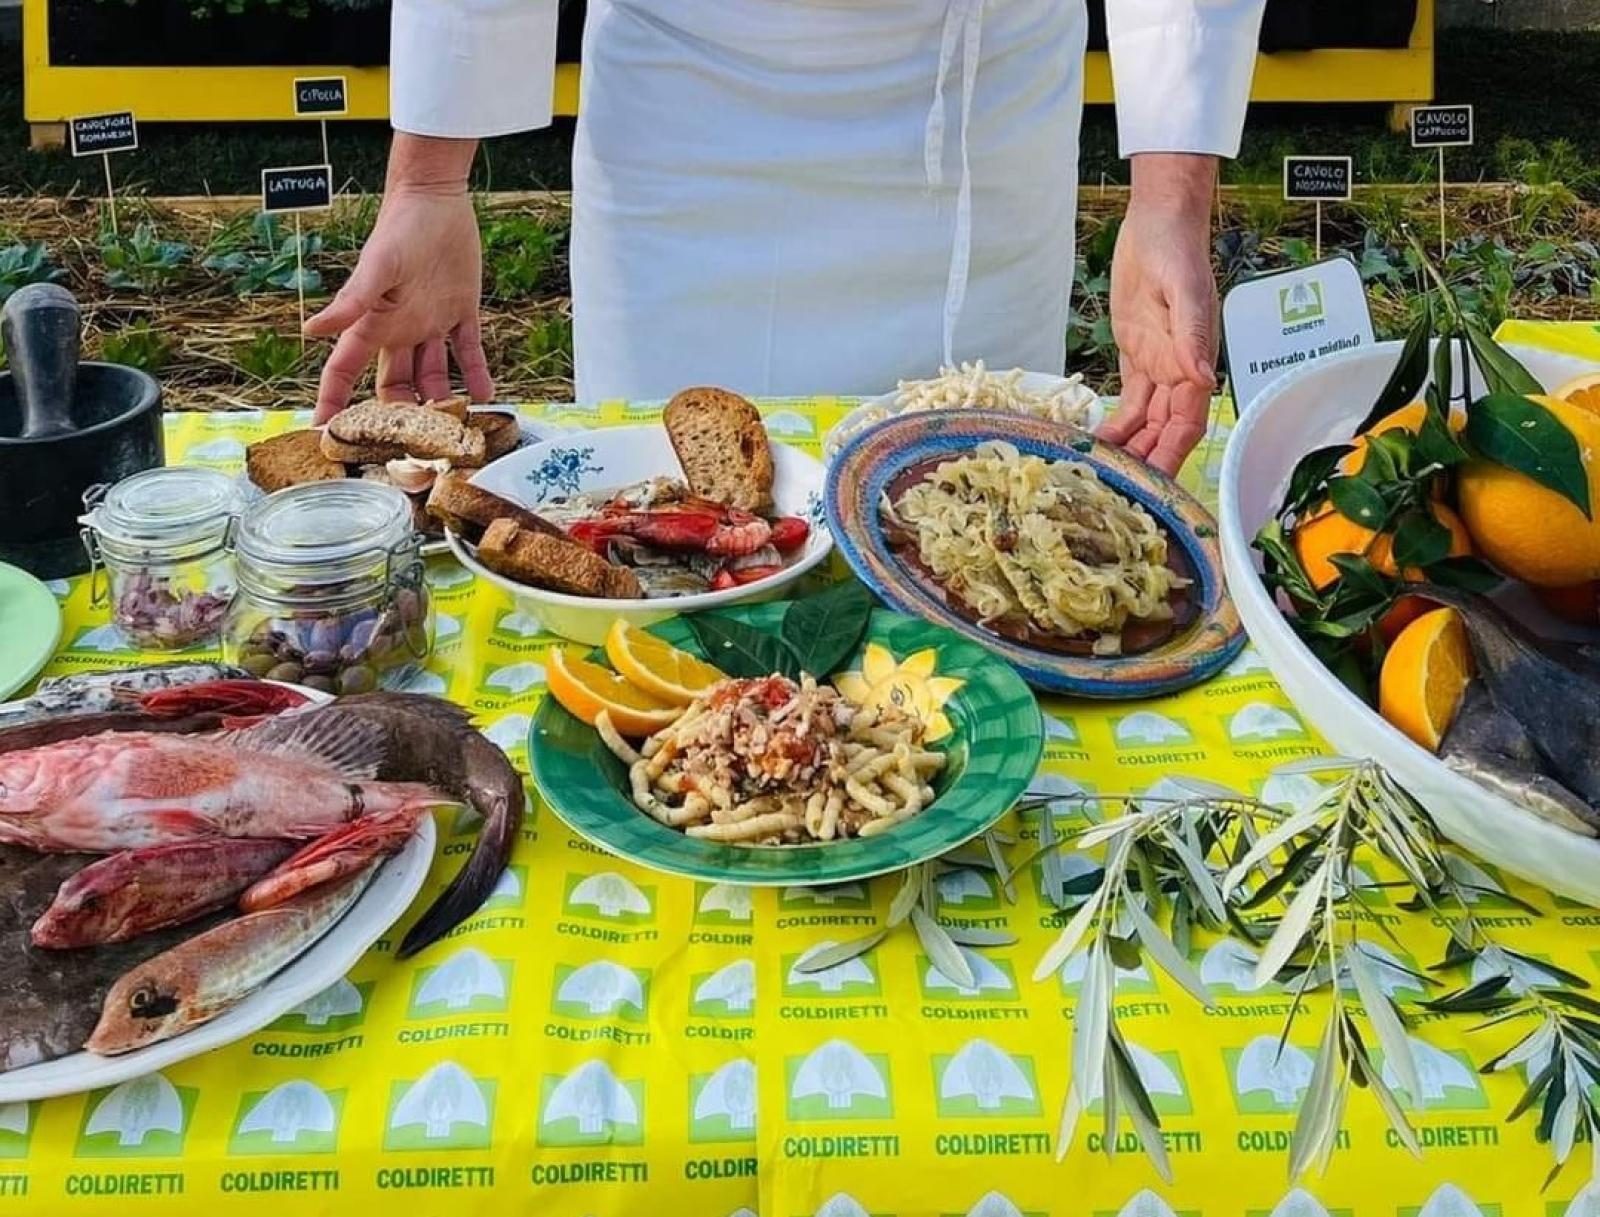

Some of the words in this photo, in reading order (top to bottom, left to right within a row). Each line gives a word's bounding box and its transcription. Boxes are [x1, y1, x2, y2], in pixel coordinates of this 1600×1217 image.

[1416, 111, 1467, 125] CAVOLO
[1294, 164, 1345, 179] CAVOLO
[269, 177, 326, 193] LATTUGA
[1282, 318, 1325, 336] COLDIRETTI
[1260, 350, 1306, 373] pescato
[1307, 348, 1317, 359] a
[1117, 751, 1206, 765] COLDIRETTI
[1232, 746, 1322, 760] COLDIRETTI
[556, 921, 659, 944] COLDIRETTI
[776, 914, 877, 929] COLDIRETTI
[779, 1003, 888, 1020] COLDIRETTI
[921, 1005, 1029, 1020] COLDIRETTI
[397, 1022, 509, 1044] COLDIRETTI
[543, 1023, 651, 1045] COLDIRETTI
[685, 1025, 754, 1040] COLDIR
[252, 1034, 363, 1058] COLDIRETTI
[784, 1135, 900, 1158] COLDIRETTI
[935, 1132, 1051, 1156] COLDIRETTI
[376, 1166, 495, 1190] COLDIRETTI
[531, 1161, 649, 1186] COLDIRETTI
[685, 1157, 758, 1181] COLDIR
[65, 1172, 184, 1195] COLDIRETTI
[220, 1169, 339, 1192] COLDIRETTI
